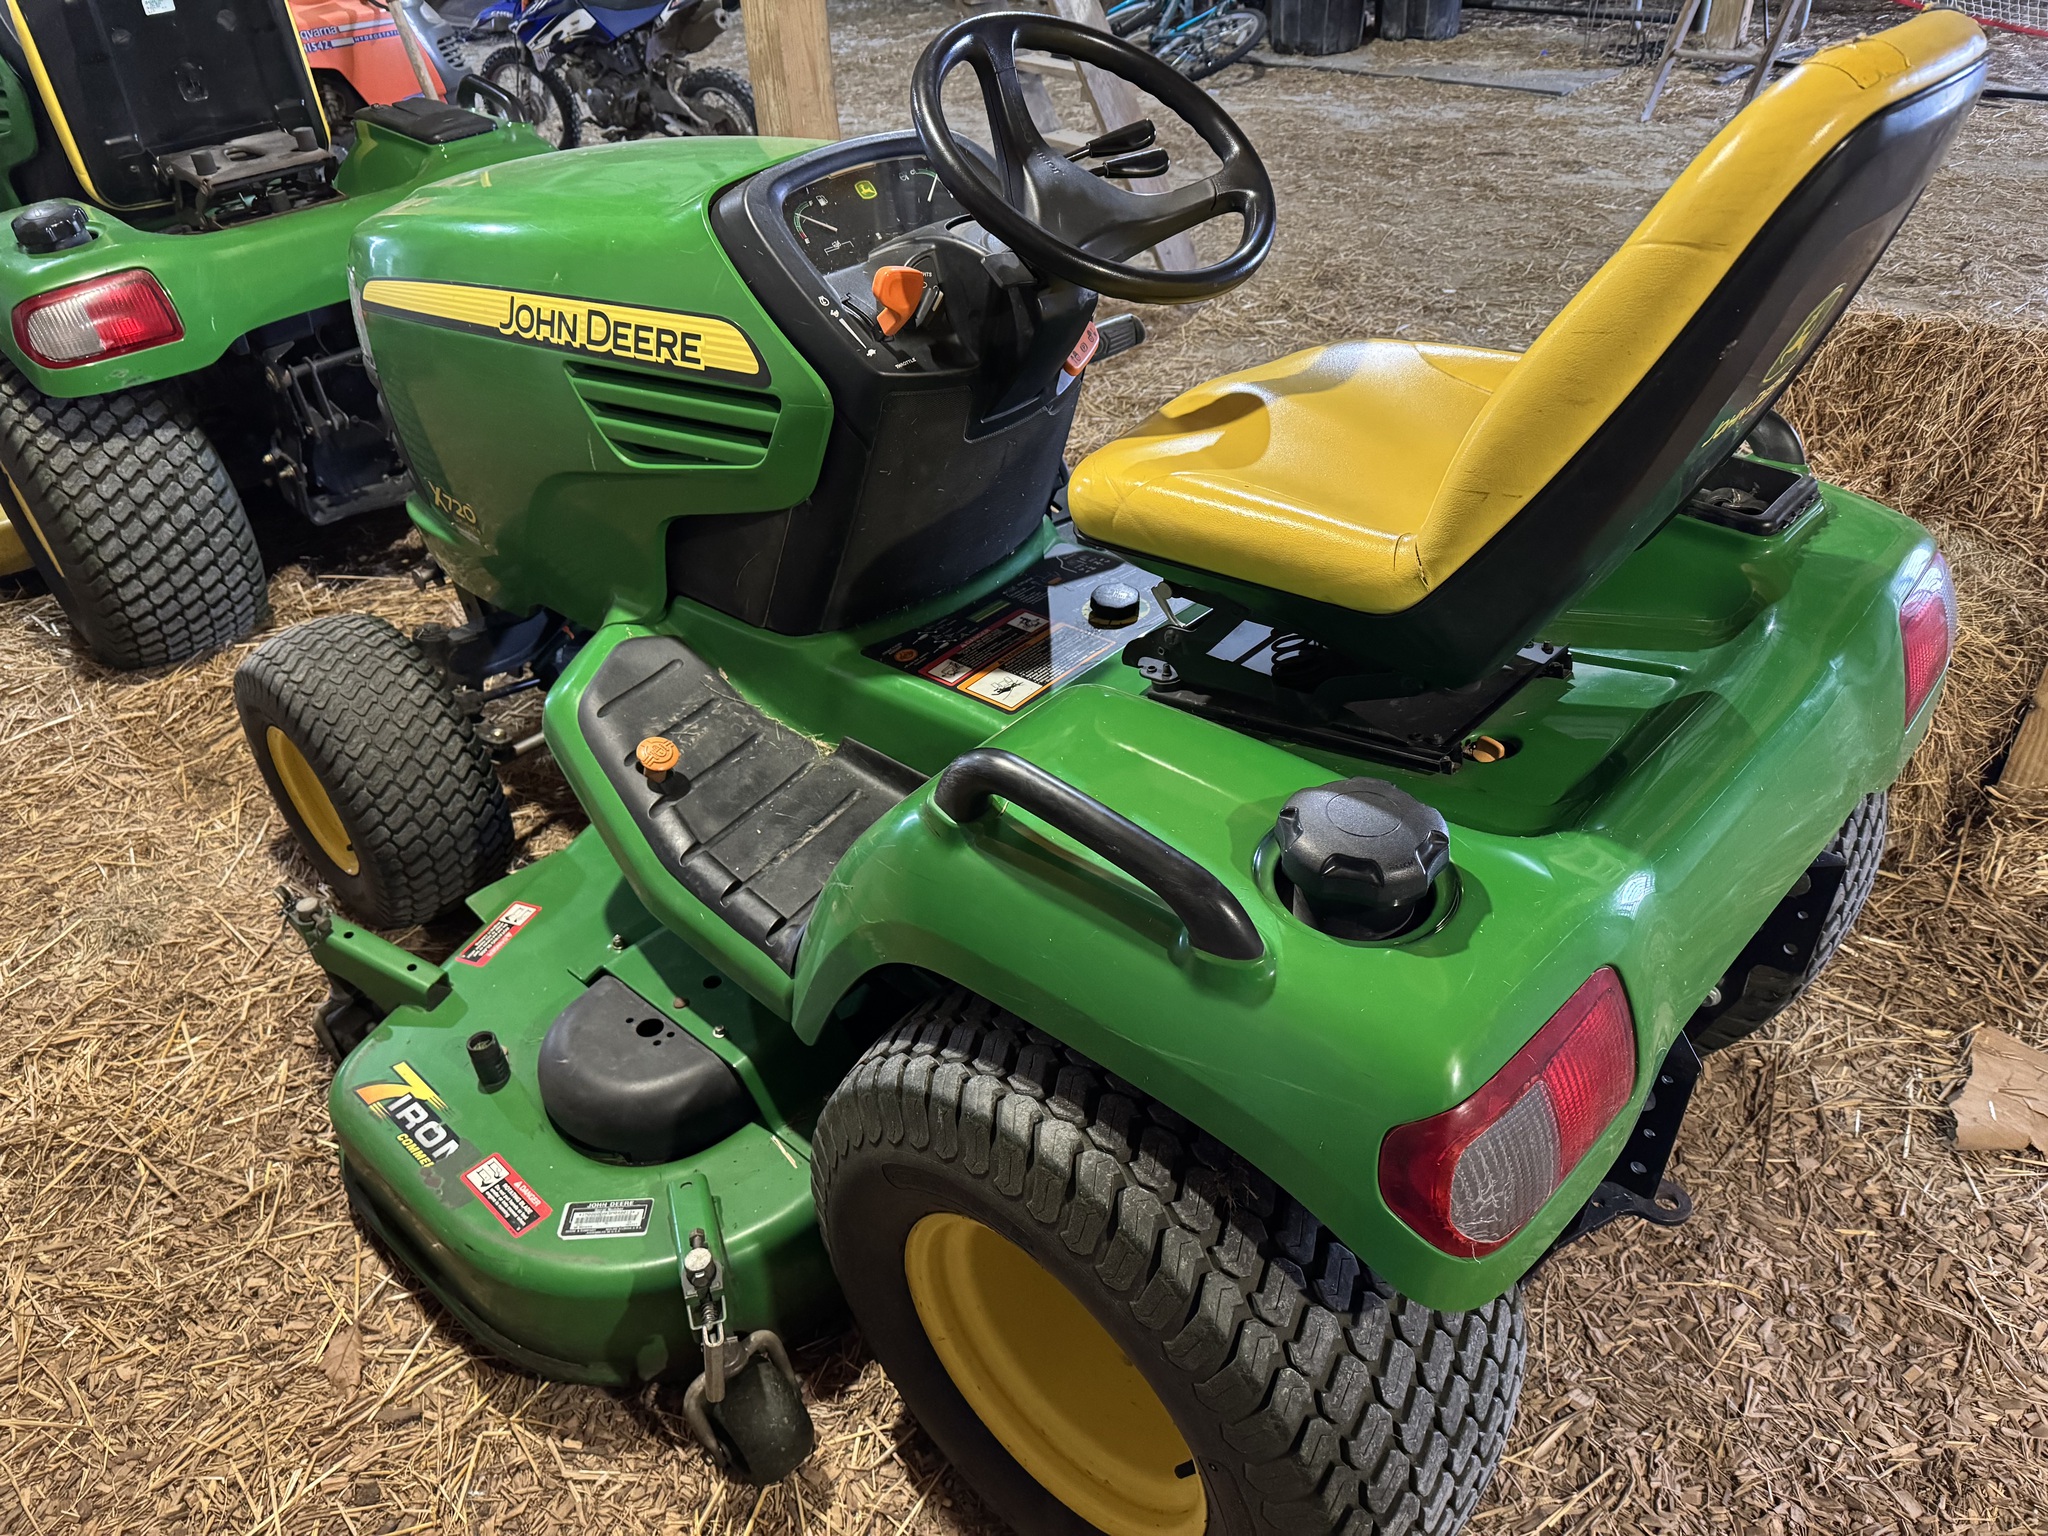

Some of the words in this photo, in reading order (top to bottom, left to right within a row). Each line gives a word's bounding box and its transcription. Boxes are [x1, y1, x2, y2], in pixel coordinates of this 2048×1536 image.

[499, 295, 579, 346] JOHN
[585, 308, 704, 369] DEERE
[428, 480, 477, 524] X720
[518, 1184, 541, 1207] DANGER
[610, 1200, 635, 1208] DEERE
